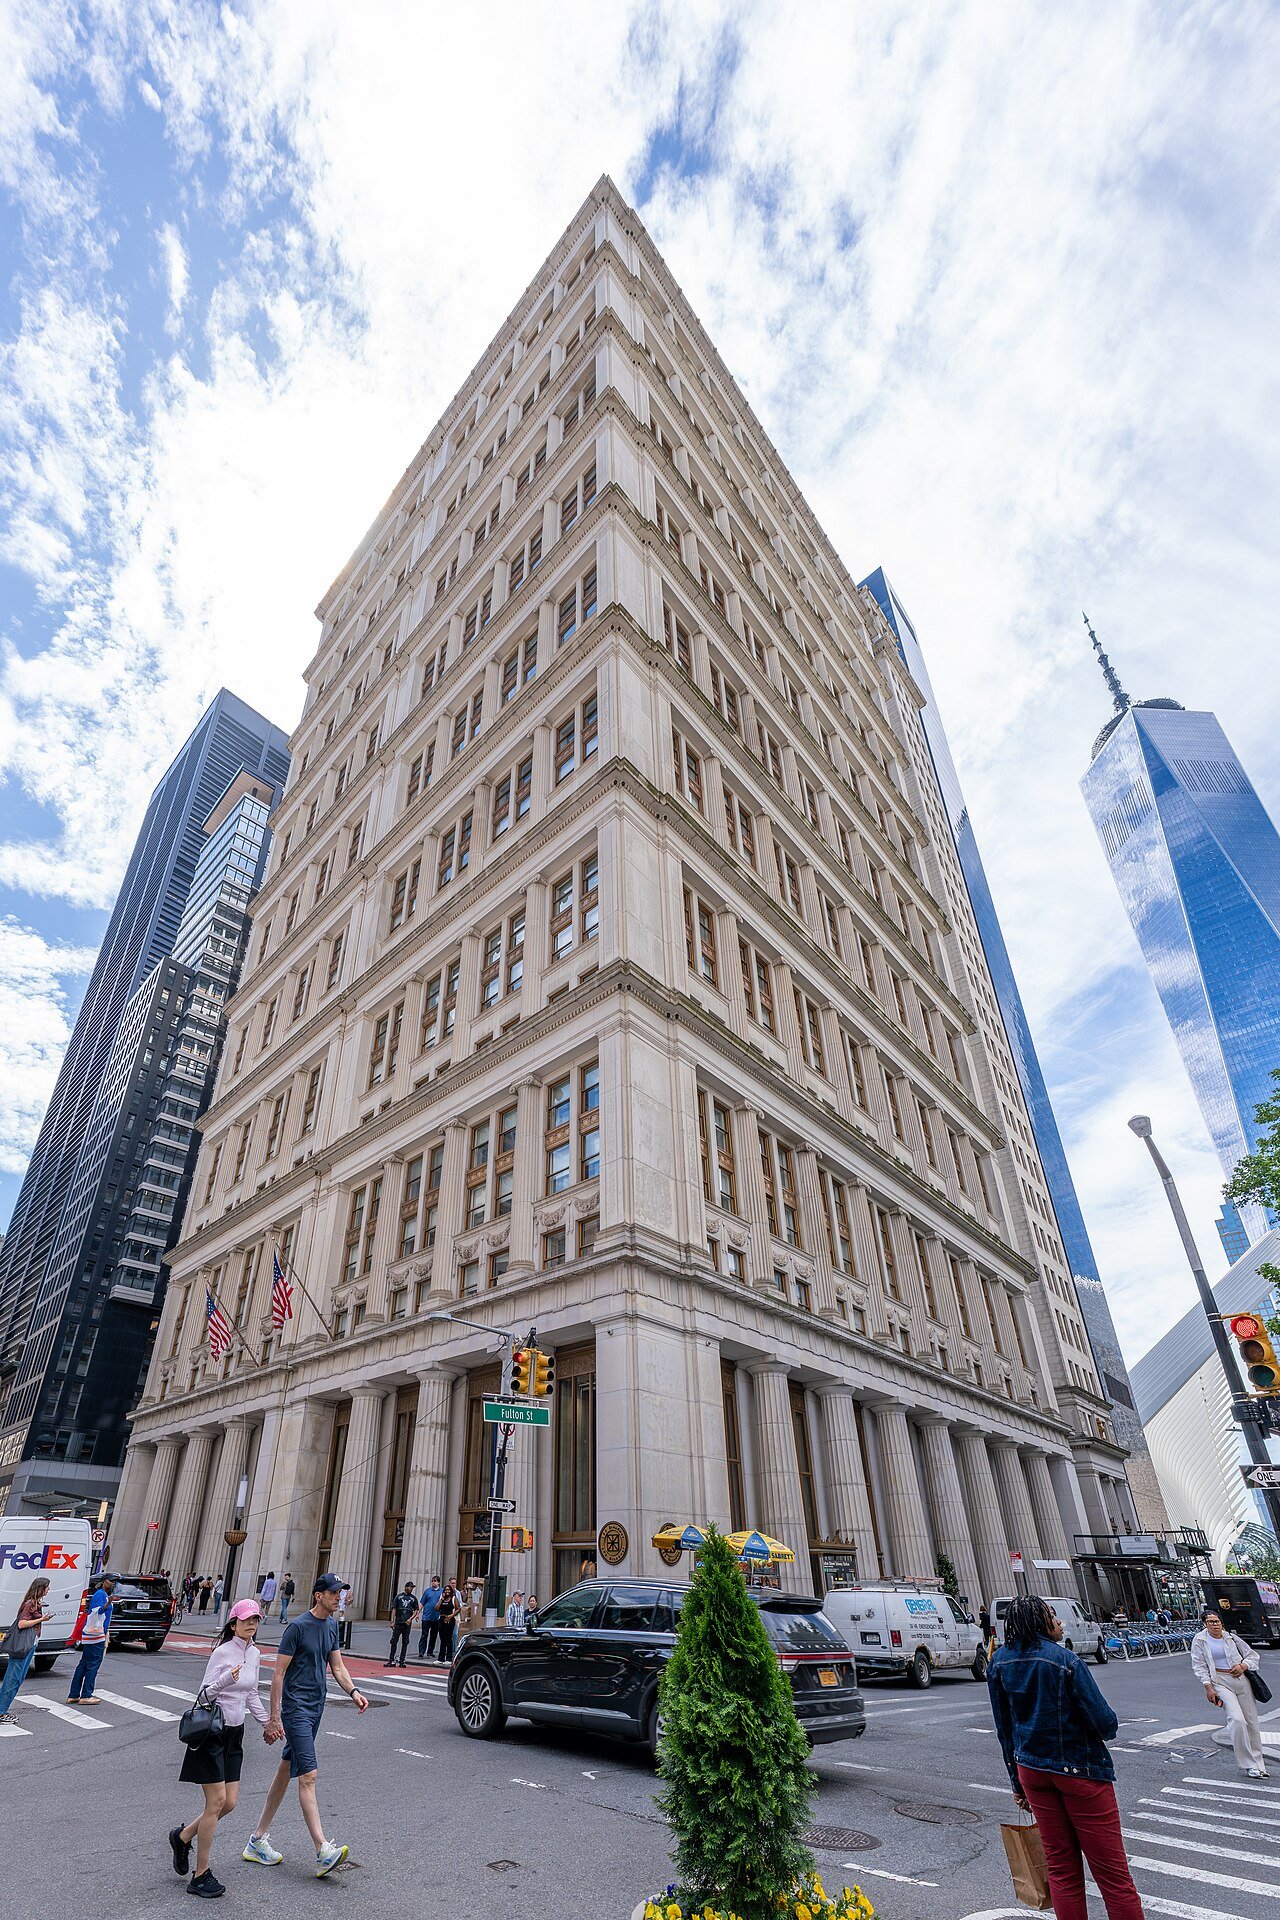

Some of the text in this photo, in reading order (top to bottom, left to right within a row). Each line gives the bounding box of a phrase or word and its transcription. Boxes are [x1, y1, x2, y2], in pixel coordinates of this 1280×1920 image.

[501, 1408, 533, 1421] Fulton St
[1256, 1472, 1276, 1481] ONE
[0, 1544, 80, 1570] FedEx
